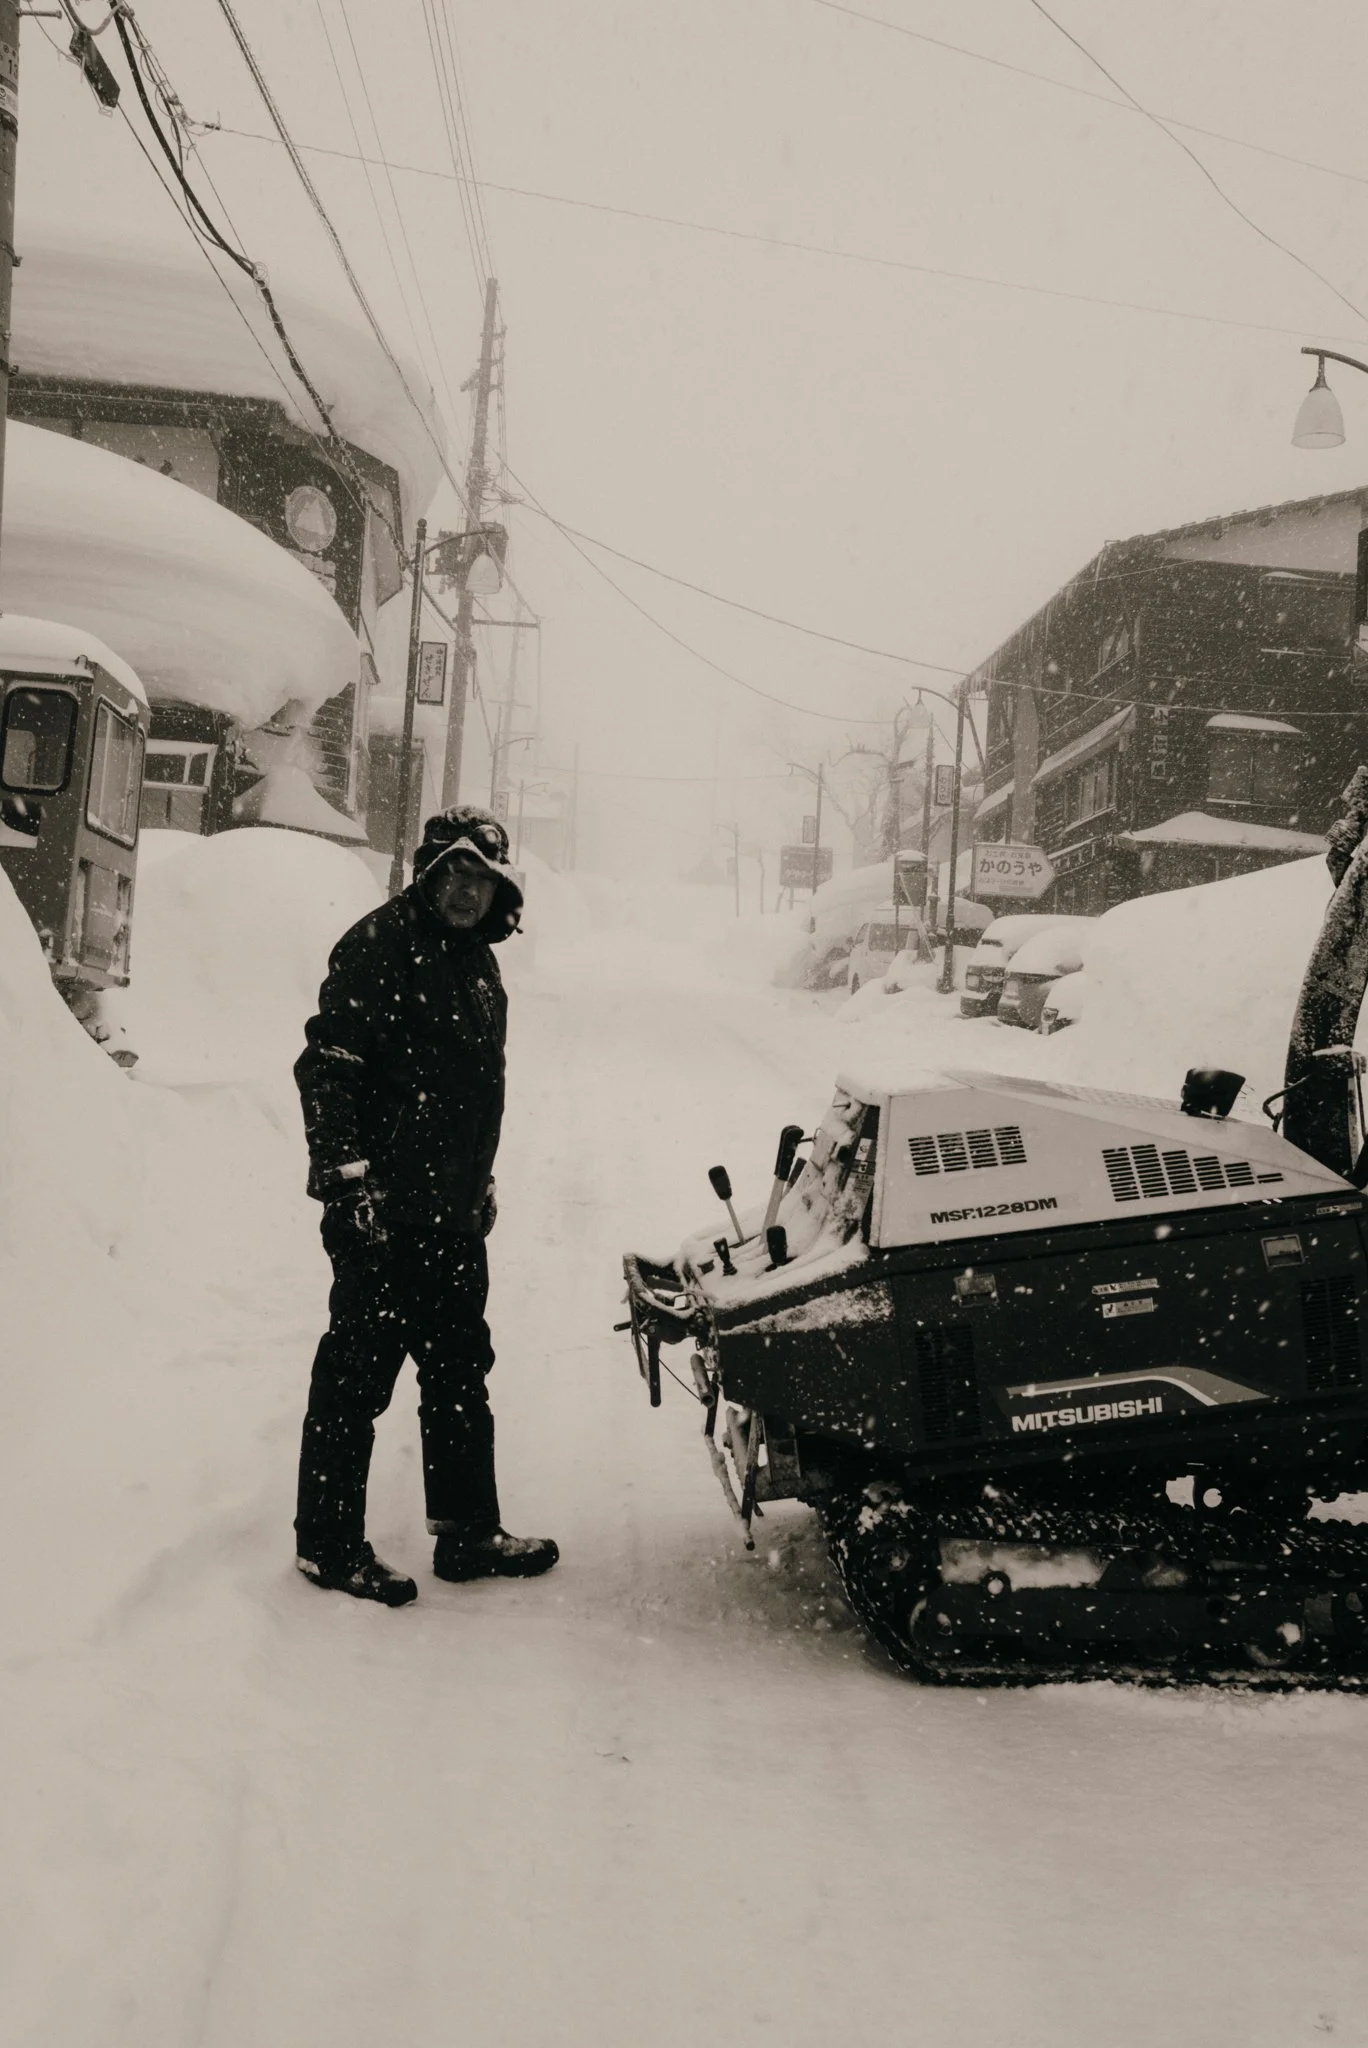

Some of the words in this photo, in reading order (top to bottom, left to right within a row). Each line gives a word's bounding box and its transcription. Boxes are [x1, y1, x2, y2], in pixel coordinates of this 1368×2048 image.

[980, 859, 1042, 876] かのうや
[1011, 1397, 1163, 1432] MITSUBISHI
